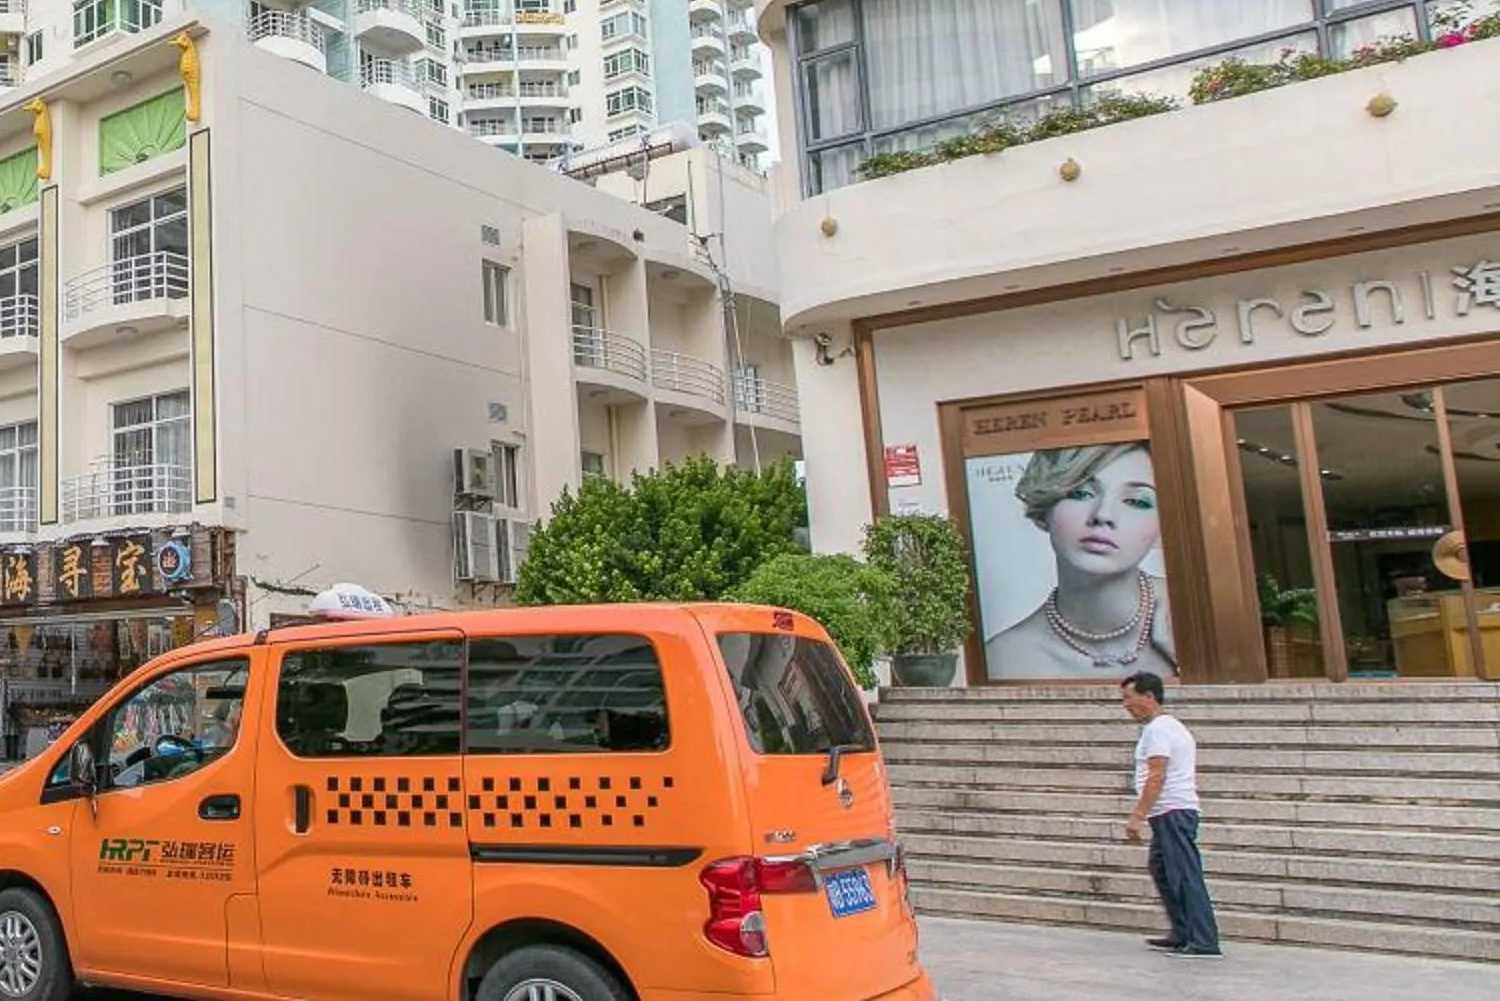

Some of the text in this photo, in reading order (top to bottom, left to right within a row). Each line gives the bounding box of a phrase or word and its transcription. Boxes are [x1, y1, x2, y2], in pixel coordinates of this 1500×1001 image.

[973, 402, 1138, 435] HEREN PEARL
[100, 838, 160, 862] HRPT
